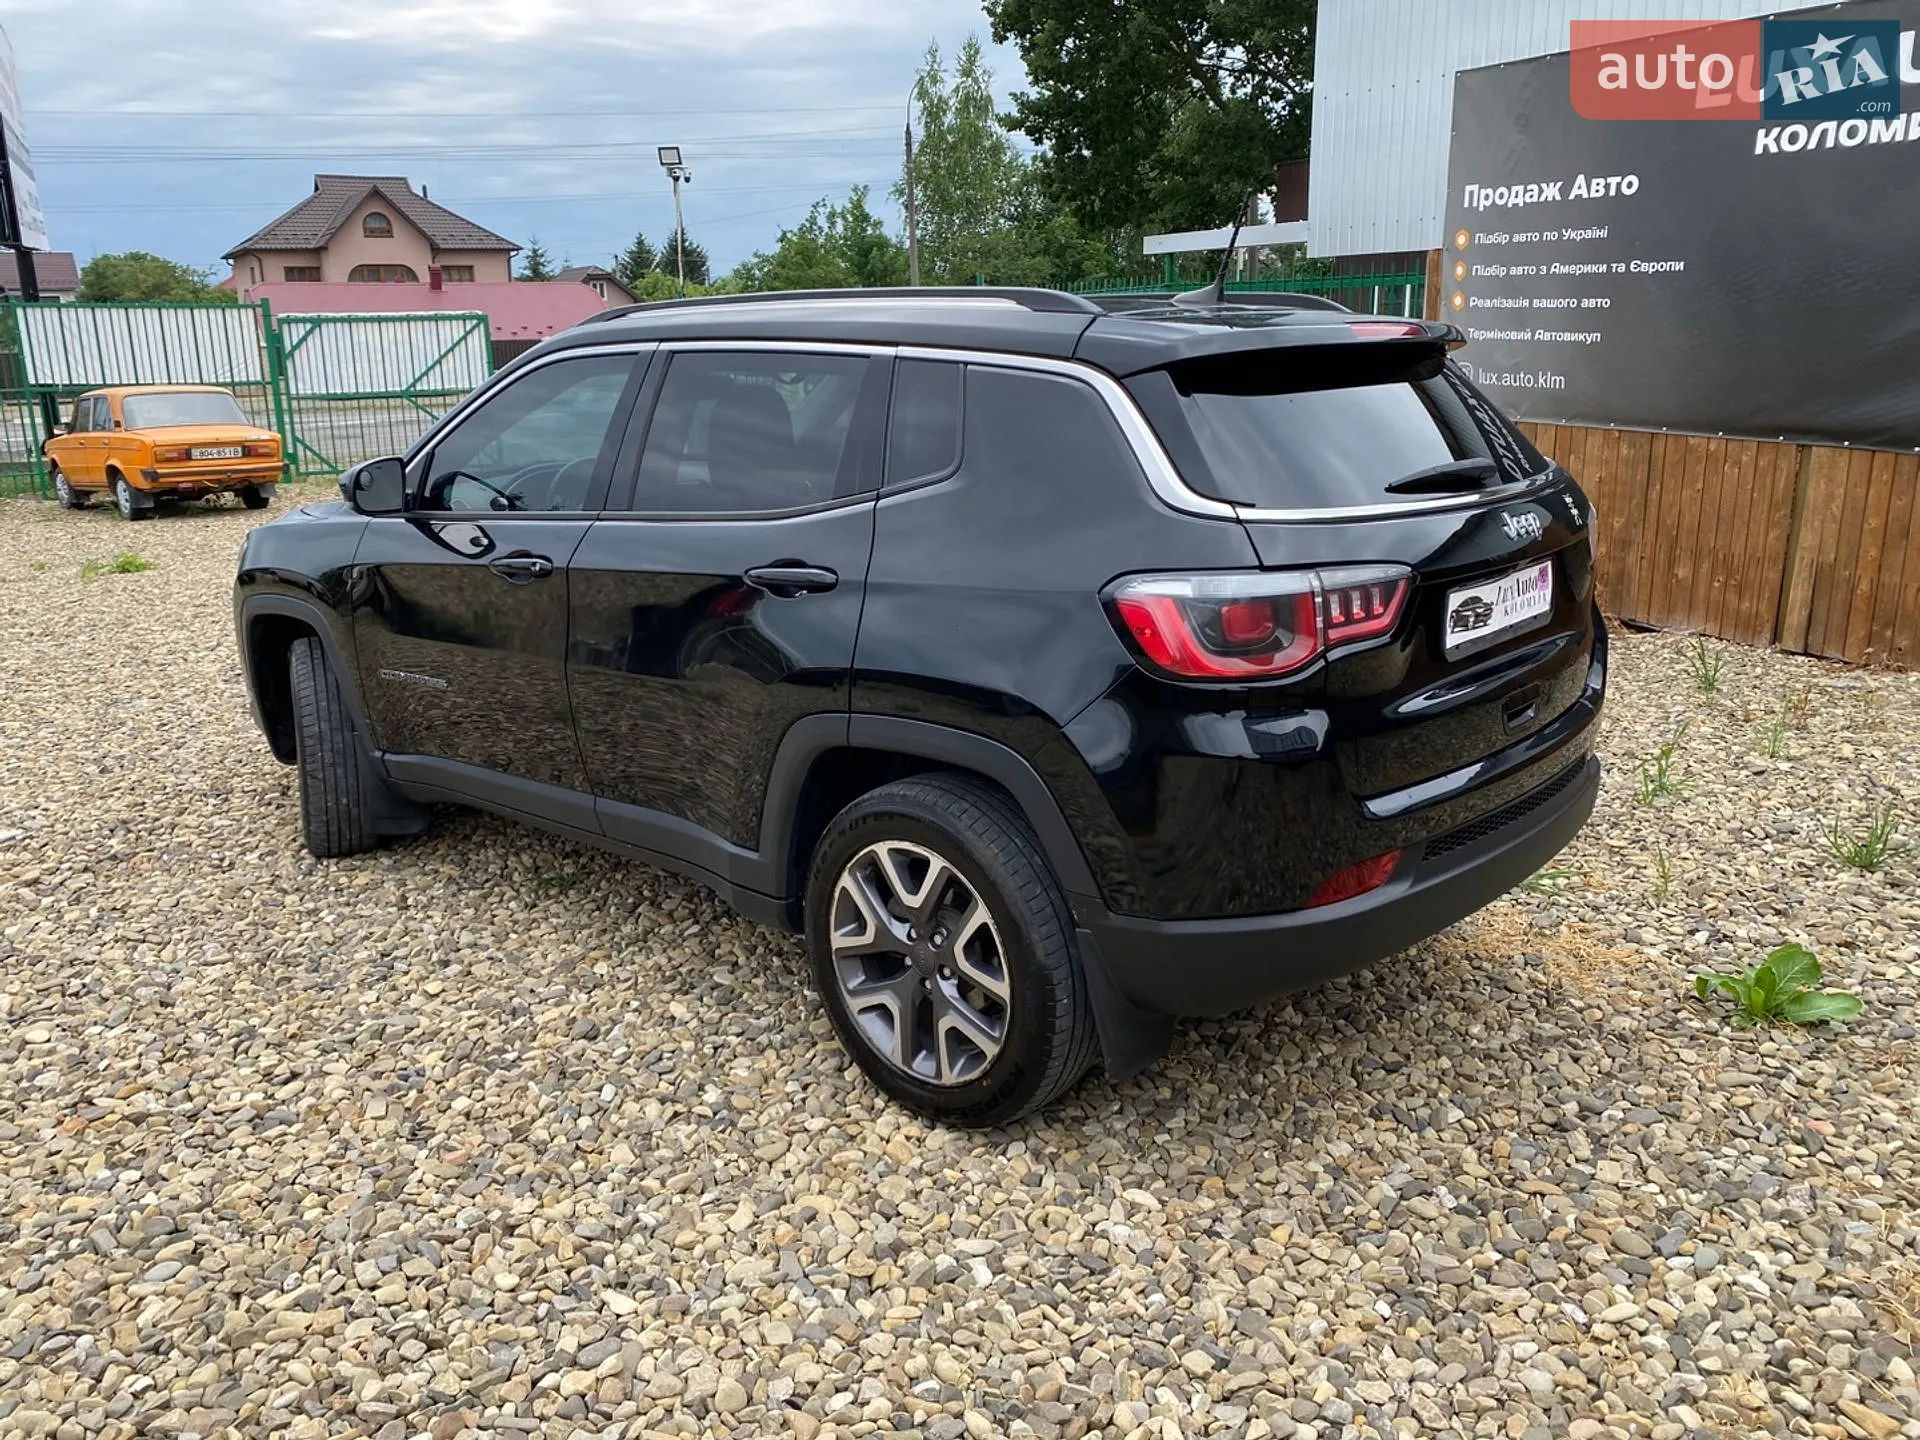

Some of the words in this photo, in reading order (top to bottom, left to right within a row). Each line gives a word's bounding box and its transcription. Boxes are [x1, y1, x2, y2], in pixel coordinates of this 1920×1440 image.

[1463, 181, 1564, 211] Продаж
[1568, 174, 1640, 200] Авто
[1474, 231, 1510, 246] Підбір
[1512, 232, 1540, 242] авто
[1543, 231, 1559, 241] по
[1562, 226, 1609, 241] Україні
[1472, 264, 1507, 277] Підбір
[1509, 265, 1536, 276] авто
[1549, 263, 1607, 276] Америки
[1610, 263, 1626, 273] та
[1629, 260, 1685, 274] Європи
[1469, 296, 1529, 308] Реалізація
[1532, 298, 1578, 308] вашого
[1581, 298, 1611, 308] авто
[1468, 327, 1532, 341] Терміновий
[1534, 329, 1601, 344] Автовикуп
[1478, 368, 1566, 389] lux.auto.klm
[1501, 511, 1542, 540] Jeep
